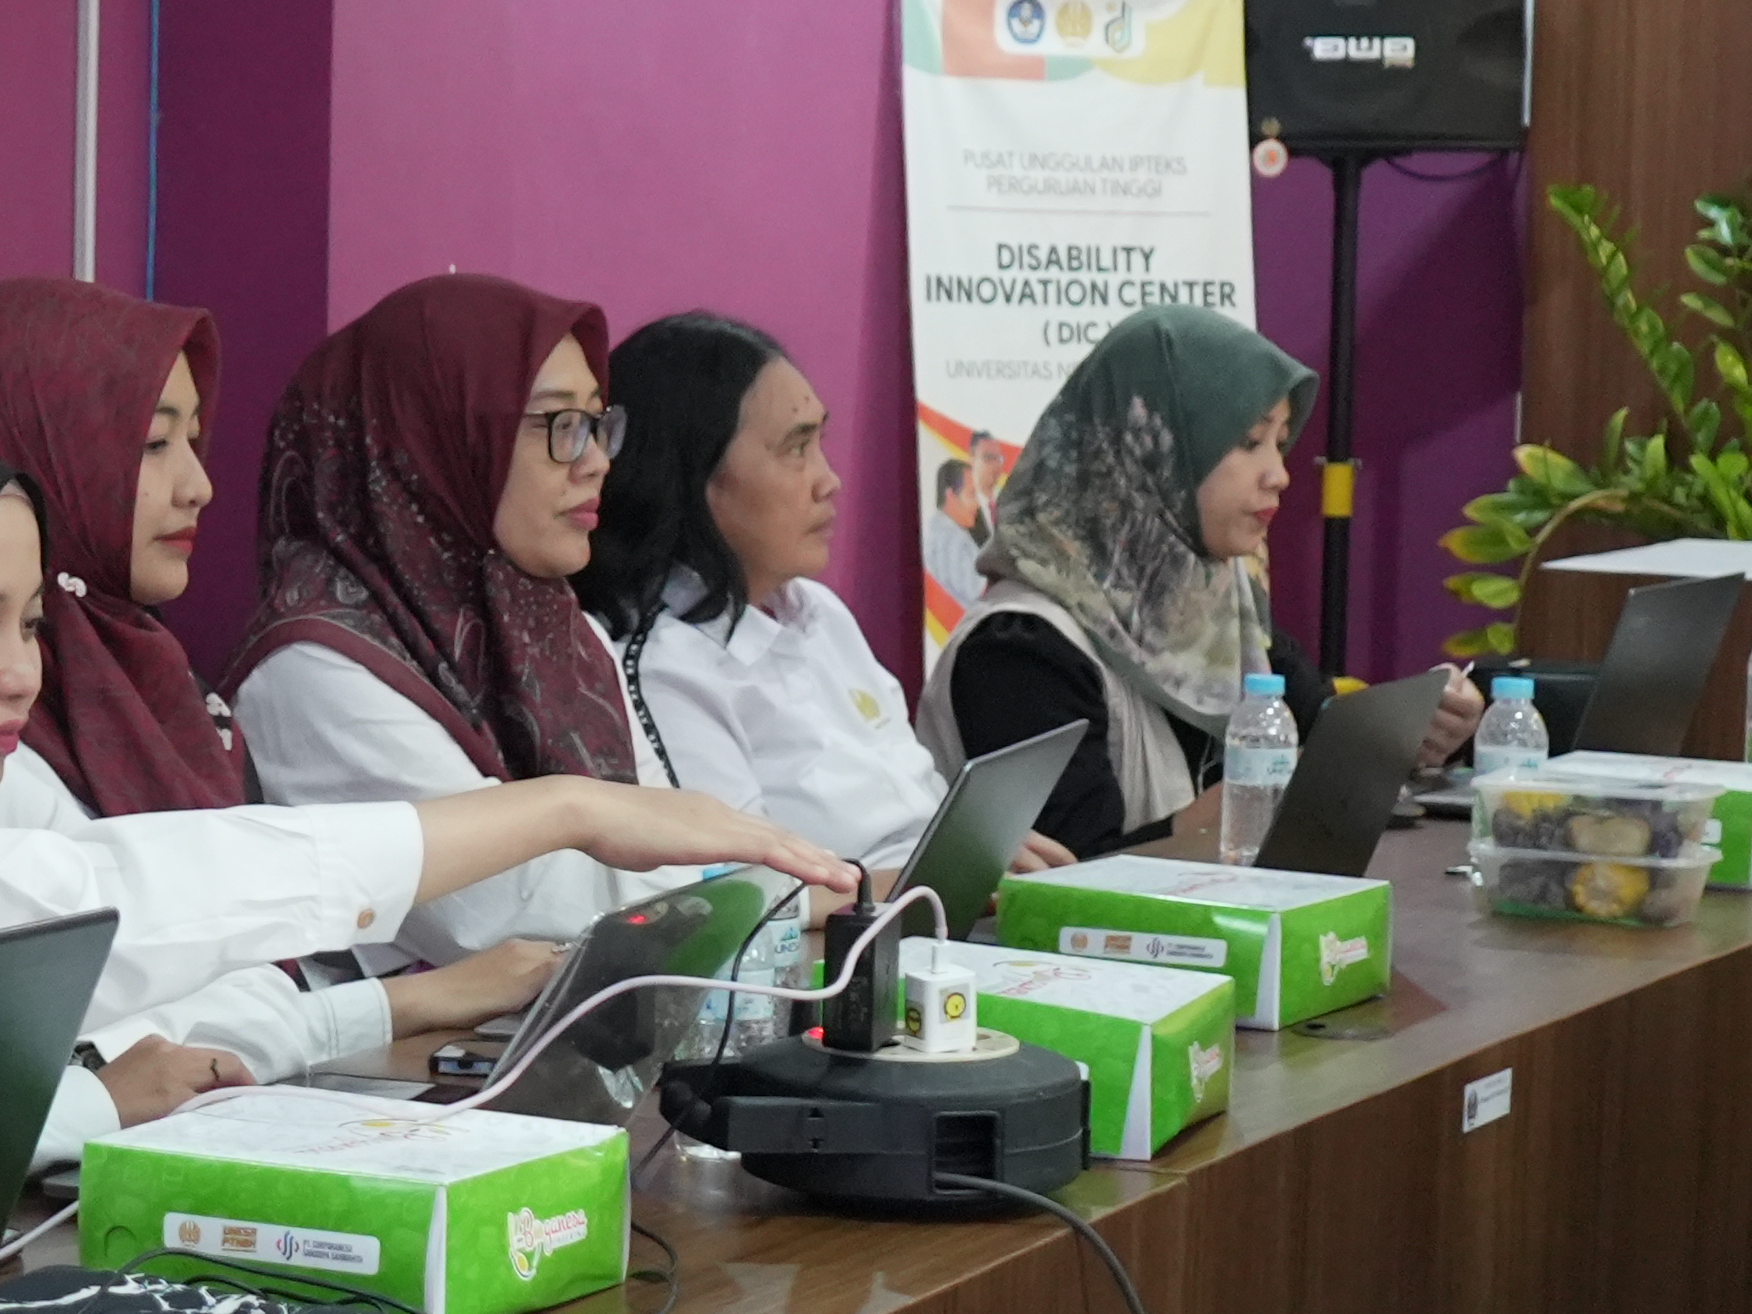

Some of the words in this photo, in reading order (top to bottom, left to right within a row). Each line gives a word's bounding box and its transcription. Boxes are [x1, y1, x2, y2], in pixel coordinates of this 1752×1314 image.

[963, 148, 1014, 170] PUSAT
[1020, 151, 1124, 174] UNGGULAN
[1129, 154, 1187, 176] IPTEKS
[986, 174, 1096, 197] PERGURUAN
[1100, 178, 1162, 199] TINGGI
[996, 243, 1155, 273] DISABILITY
[925, 274, 1109, 307] INNOVATION
[1117, 279, 1237, 309] CENTER
[945, 360, 1053, 382] UNIVERSITAS
